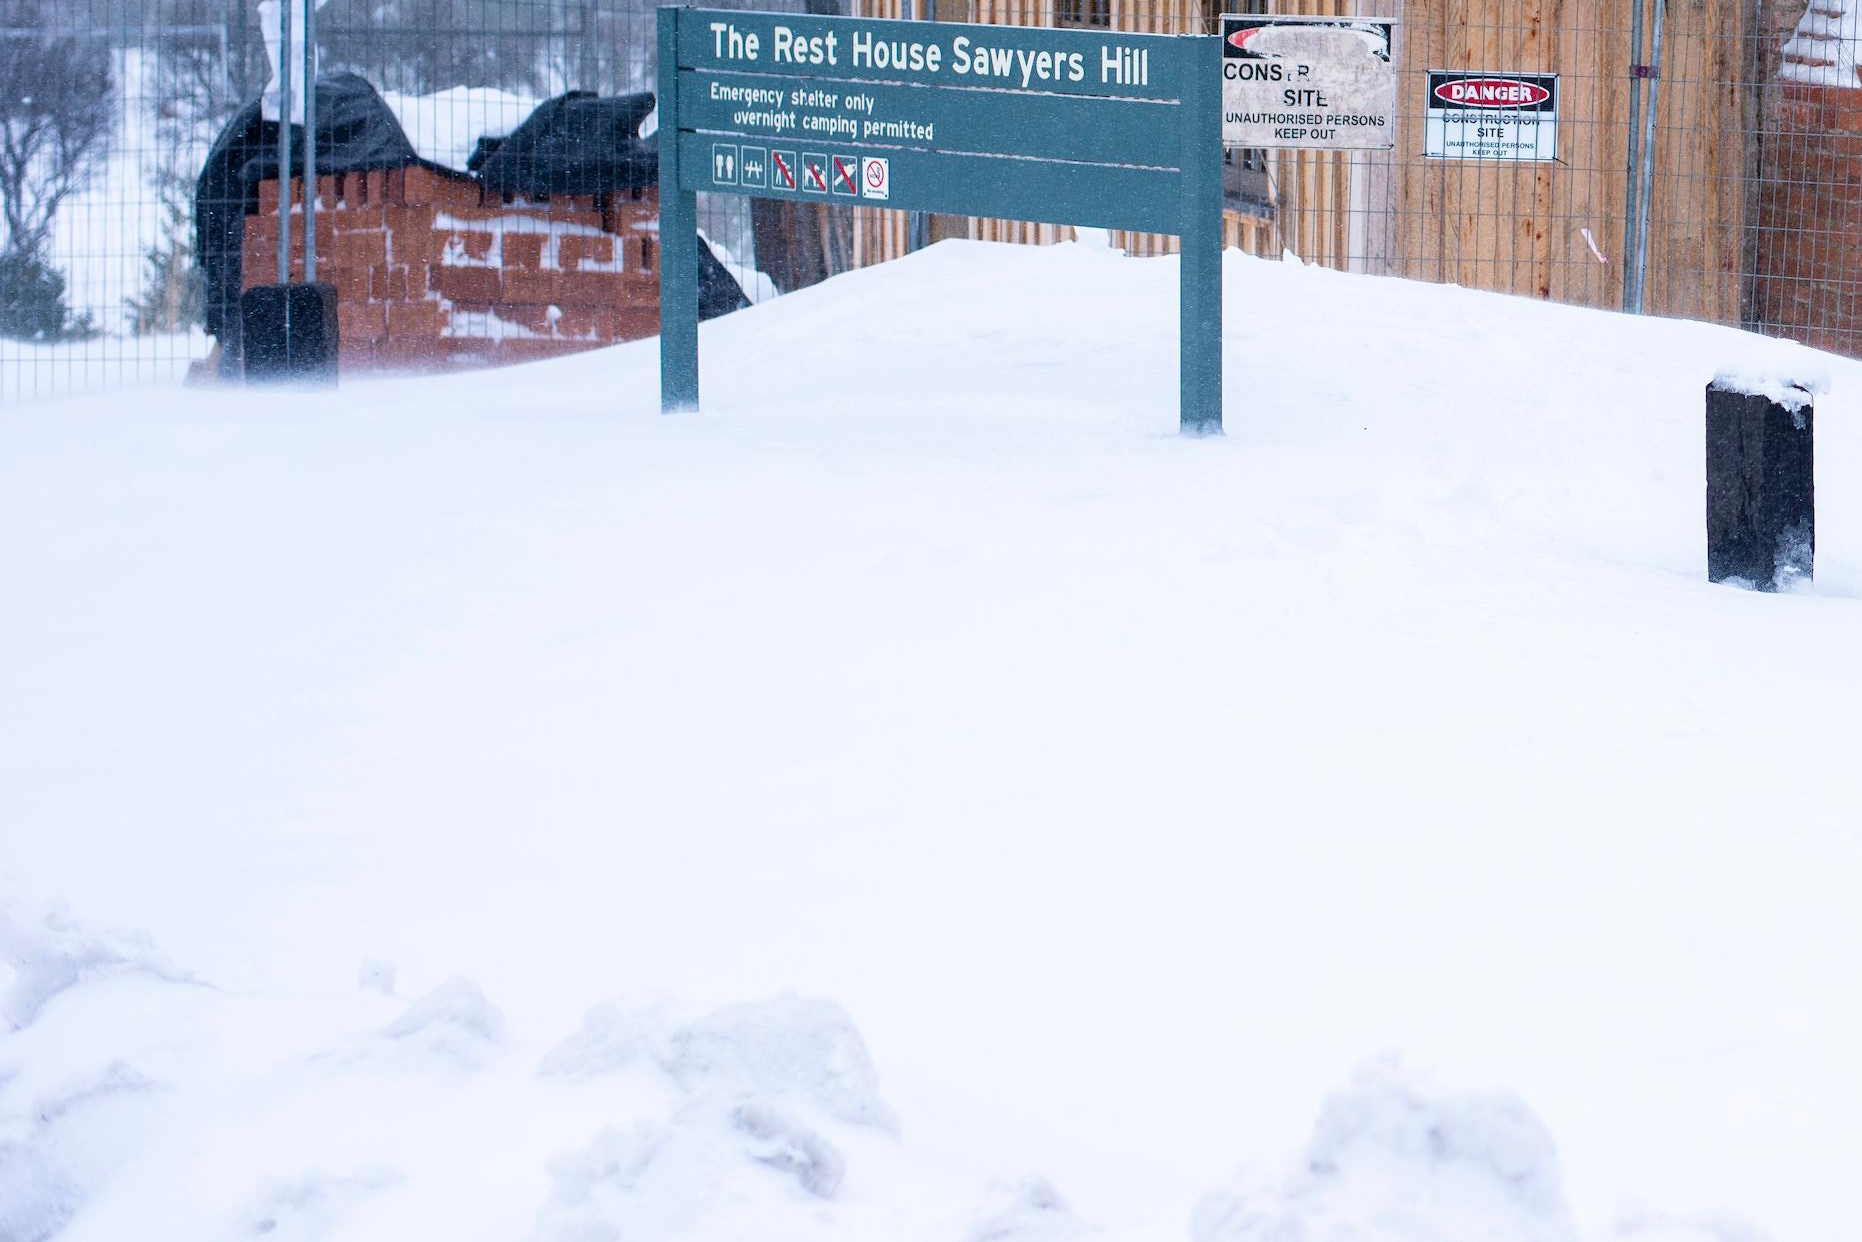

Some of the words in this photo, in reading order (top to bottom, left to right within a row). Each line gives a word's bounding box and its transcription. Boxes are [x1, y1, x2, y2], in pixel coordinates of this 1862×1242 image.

[710, 23, 760, 60] The
[774, 26, 838, 65] Rest
[852, 31, 942, 72] House
[952, 36, 1085, 88] Sawyers
[1101, 45, 1148, 86] Hill
[711, 82, 784, 108] Emergency
[791, 88, 838, 109] shelter
[845, 93, 875, 115] only
[1283, 89, 1328, 107] SITE
[1451, 85, 1533, 101] DANGER
[734, 110, 796, 133] overnight
[803, 114, 858, 139] camping
[864, 118, 934, 141] permitted
[1226, 112, 1323, 125] UNAUTHORISED
[1326, 115, 1385, 126] PERSONS
[1442, 113, 1540, 126] CONSTRUCTION
[1274, 128, 1307, 139] KEEP
[1310, 129, 1336, 140] OUT
[1477, 127, 1504, 138] SITE
[1446, 141, 1500, 149] UNAUTHORISED
[1501, 142, 1535, 150] PERSONS
